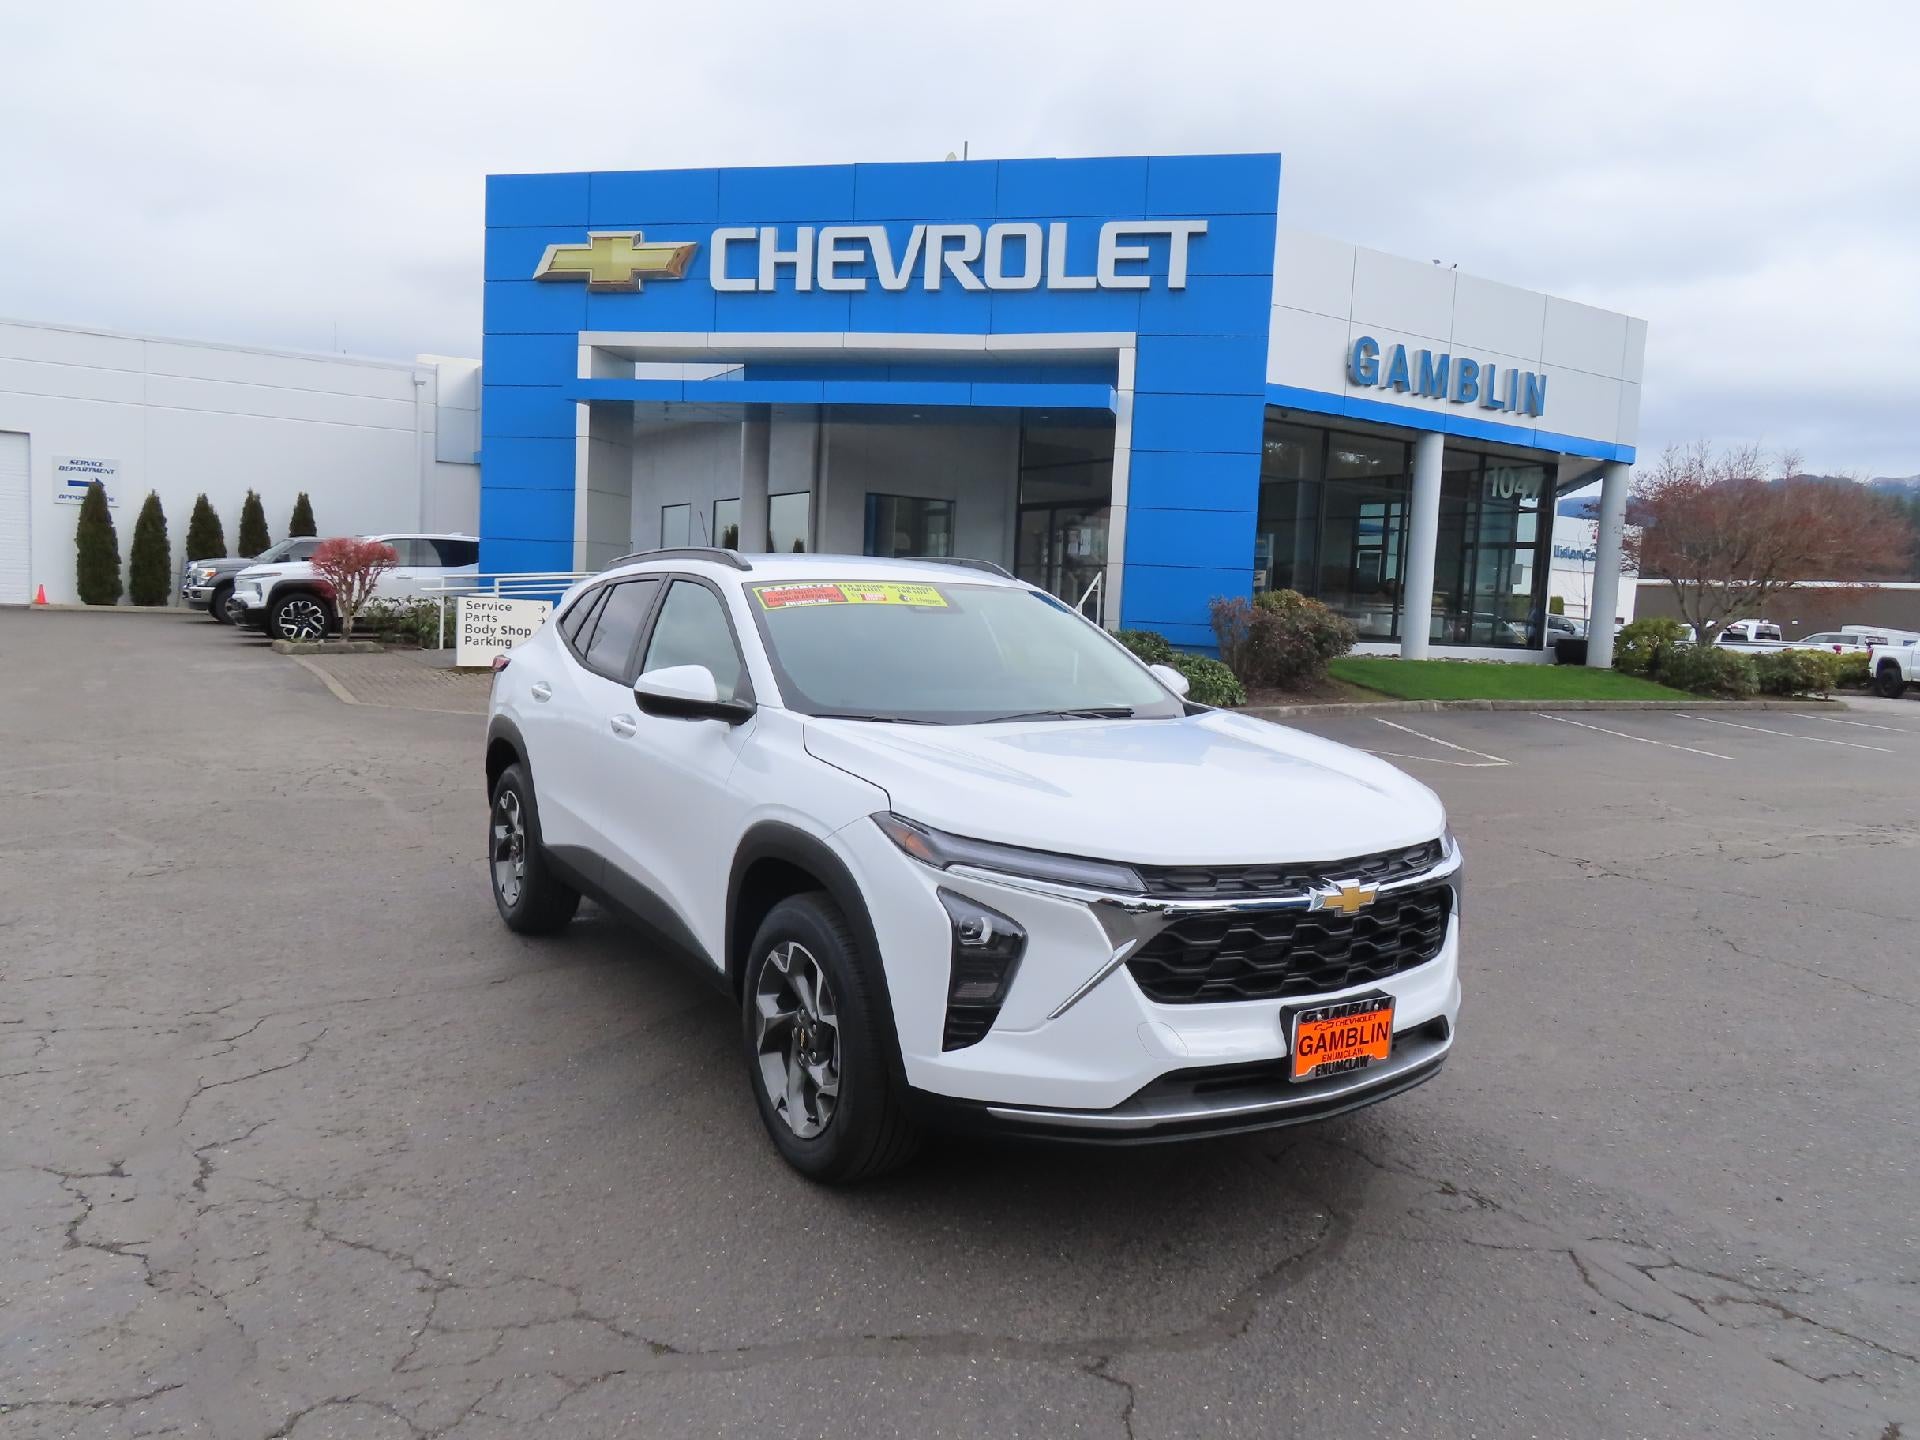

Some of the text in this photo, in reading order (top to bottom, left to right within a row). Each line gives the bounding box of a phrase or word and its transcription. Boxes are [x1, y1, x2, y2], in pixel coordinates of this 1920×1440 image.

[709, 219, 1208, 292] CHEVROLET
[1346, 335, 1547, 417] GAMBLIN
[58, 465, 115, 474] DEPARTMENT
[69, 459, 104, 467] SERVICE
[1491, 466, 1544, 502] 1047
[466, 600, 512, 612] Service
[465, 612, 498, 623] Parts
[465, 624, 532, 638] Body Shop
[465, 635, 512, 650] Parking
[1335, 1013, 1378, 1027] CHEVROLET
[1298, 1021, 1390, 1057] GAMBLIN
[1321, 1047, 1364, 1063] ENUMCLAW
[1315, 1054, 1370, 1077] ENUMCLAW
